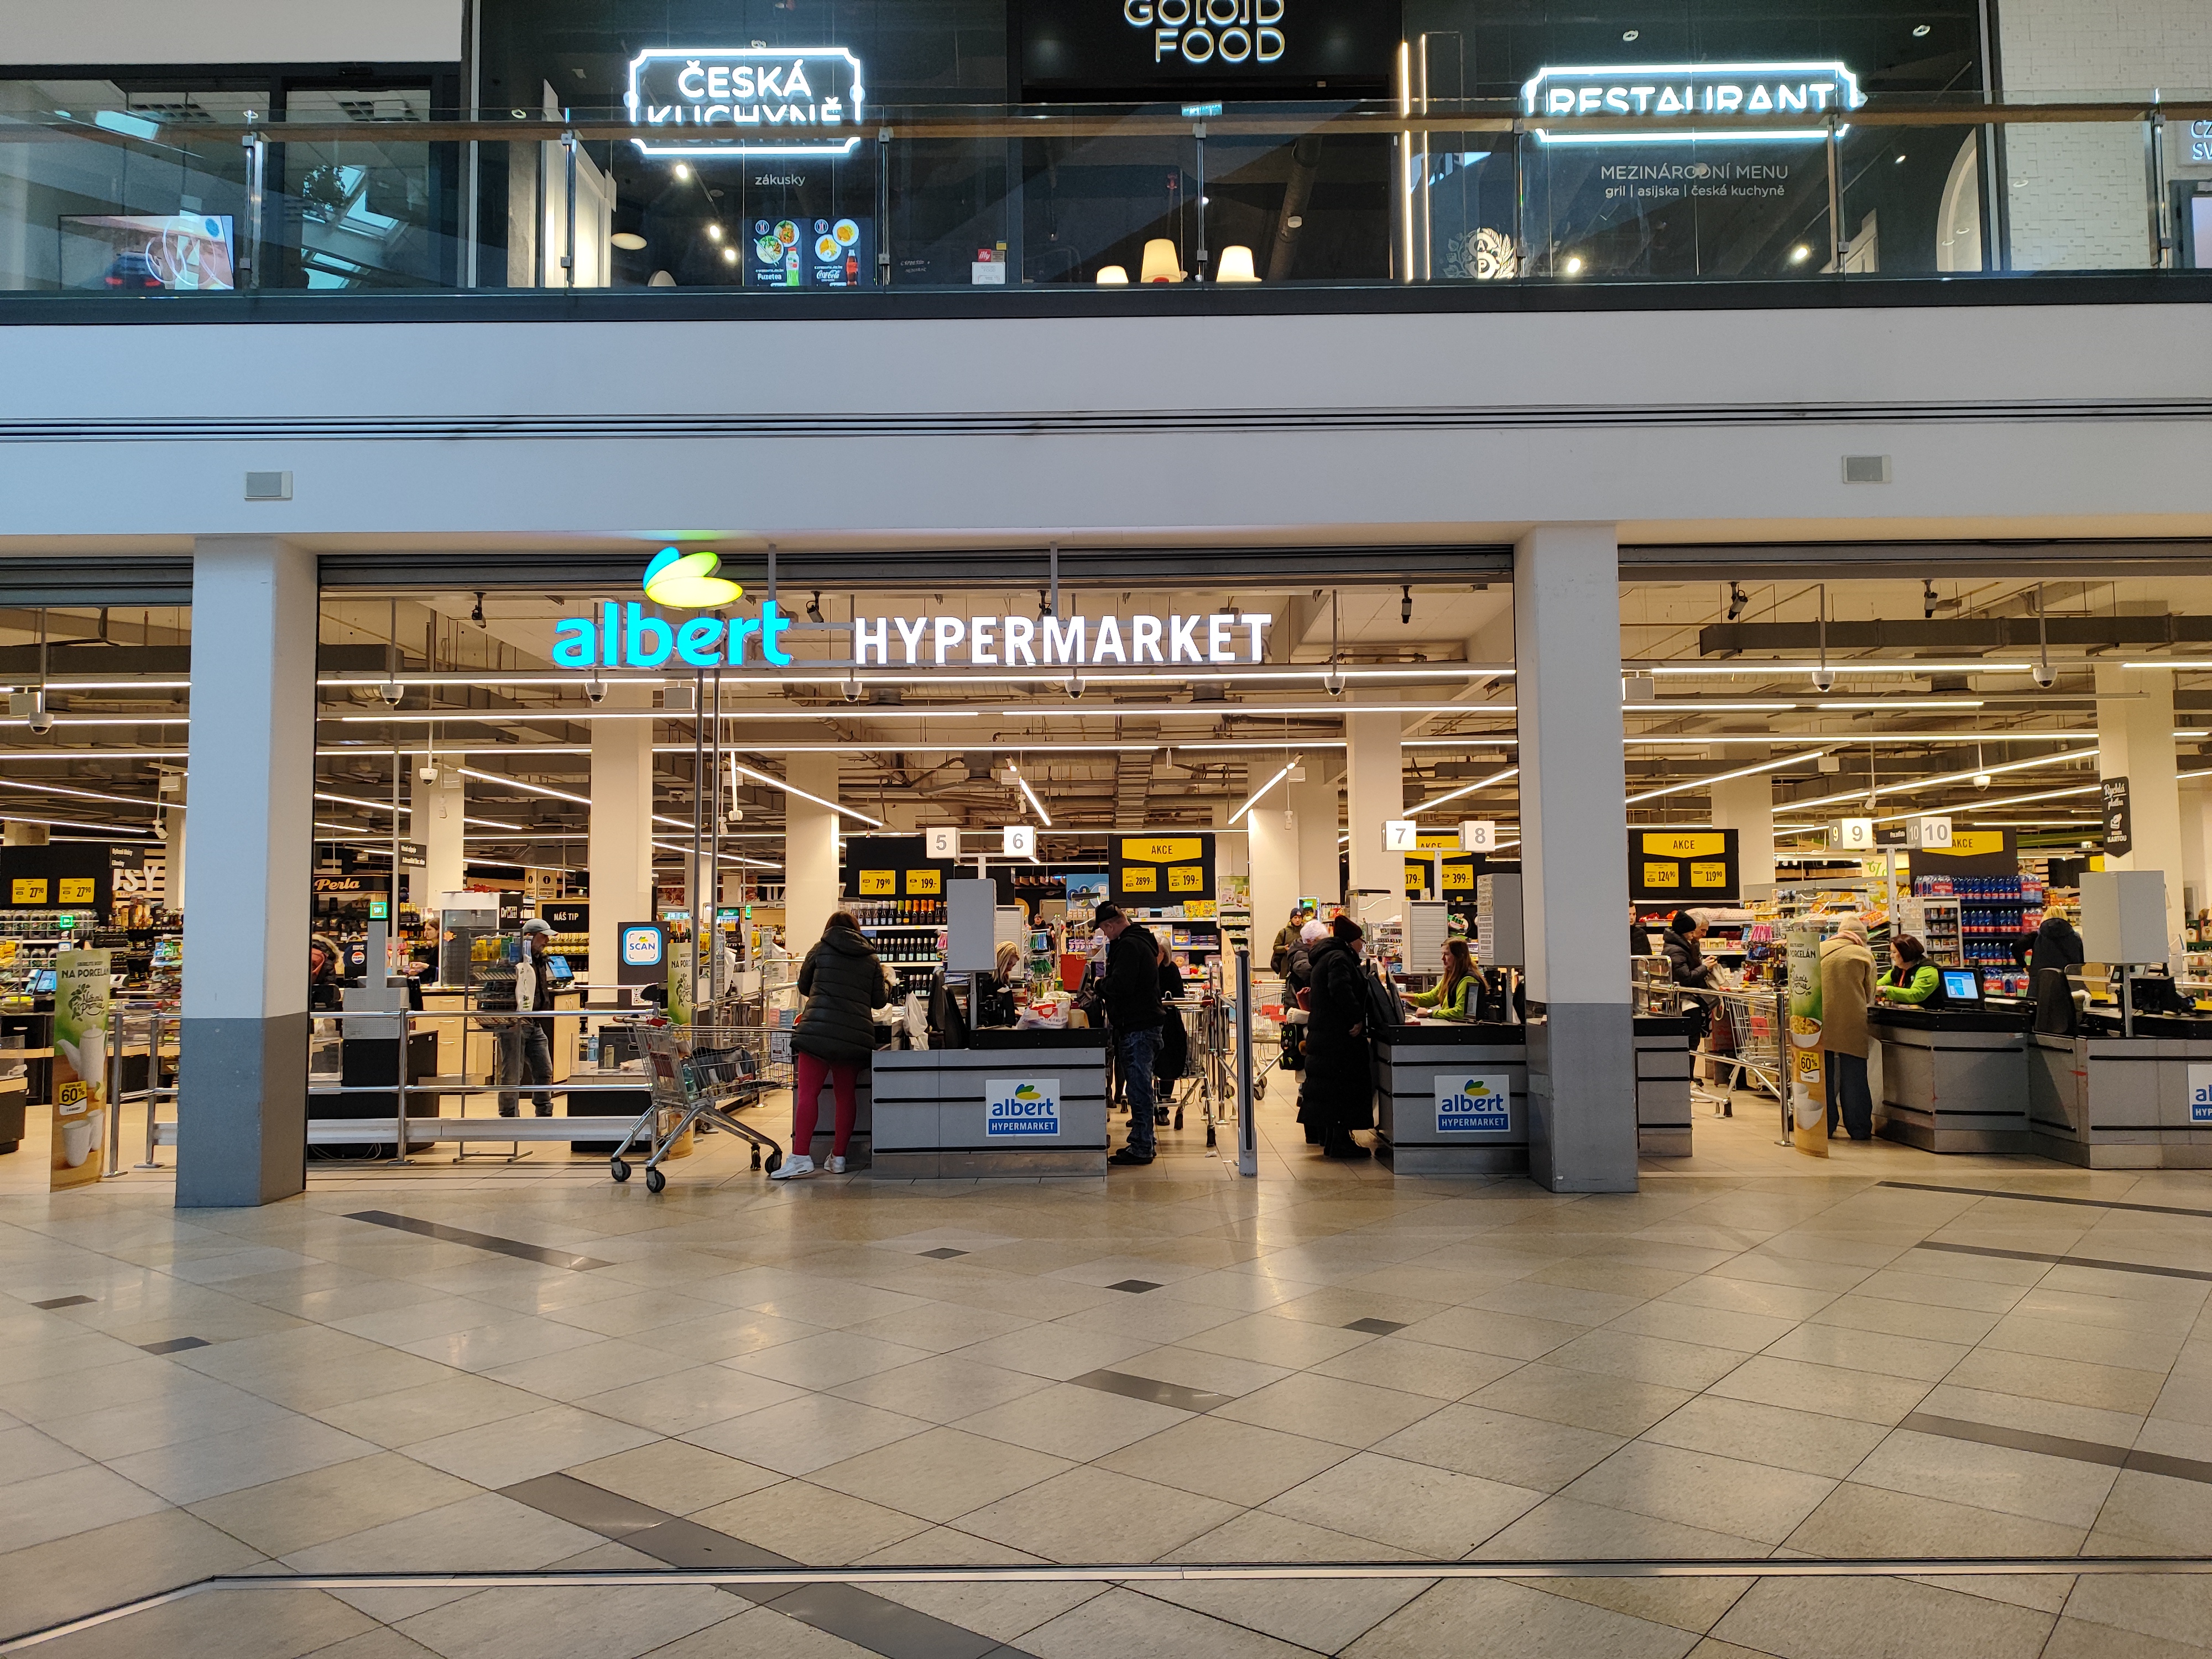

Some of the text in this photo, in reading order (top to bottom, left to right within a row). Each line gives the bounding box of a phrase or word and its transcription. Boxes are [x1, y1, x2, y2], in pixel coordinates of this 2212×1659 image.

[1155, 27, 1285, 62] FOOD
[678, 58, 812, 98] ČESKÁ
[1550, 83, 1835, 113] RESTAURANT
[1601, 163, 1788, 180] MEZINÁRODNÍ MENU
[754, 174, 806, 187] zákusky
[1605, 184, 1625, 199] gril
[1691, 184, 1726, 196] česká
[1731, 185, 1785, 197] kuchyně
[979, 251, 990, 260] illy
[553, 600, 1272, 667] albert HYPERMARKET
[1395, 828, 1406, 844] 7
[1475, 827, 1486, 844] 8
[1832, 826, 1839, 842] 9
[1852, 826, 1863, 842] 9
[1909, 825, 1919, 841] 10
[1924, 824, 1948, 841] 10
[936, 834, 947, 851] 5
[1013, 833, 1024, 849] 6
[1673, 840, 1695, 849] AKCE
[1952, 838, 1974, 848] AKCE
[1151, 845, 1173, 855] AKCE
[314, 878, 361, 891] Perla
[554, 911, 579, 921] NÁŠ TIP
[61, 969, 76, 978] NA
[1801, 1057, 1818, 1070] 60%
[61, 1087, 85, 1103] 60%
[1441, 1094, 1505, 1112] albert
[992, 1098, 1055, 1116] albert
[992, 1121, 1055, 1131] HYPERMARKET
[1441, 1118, 1505, 1127] HYPERMARKET
